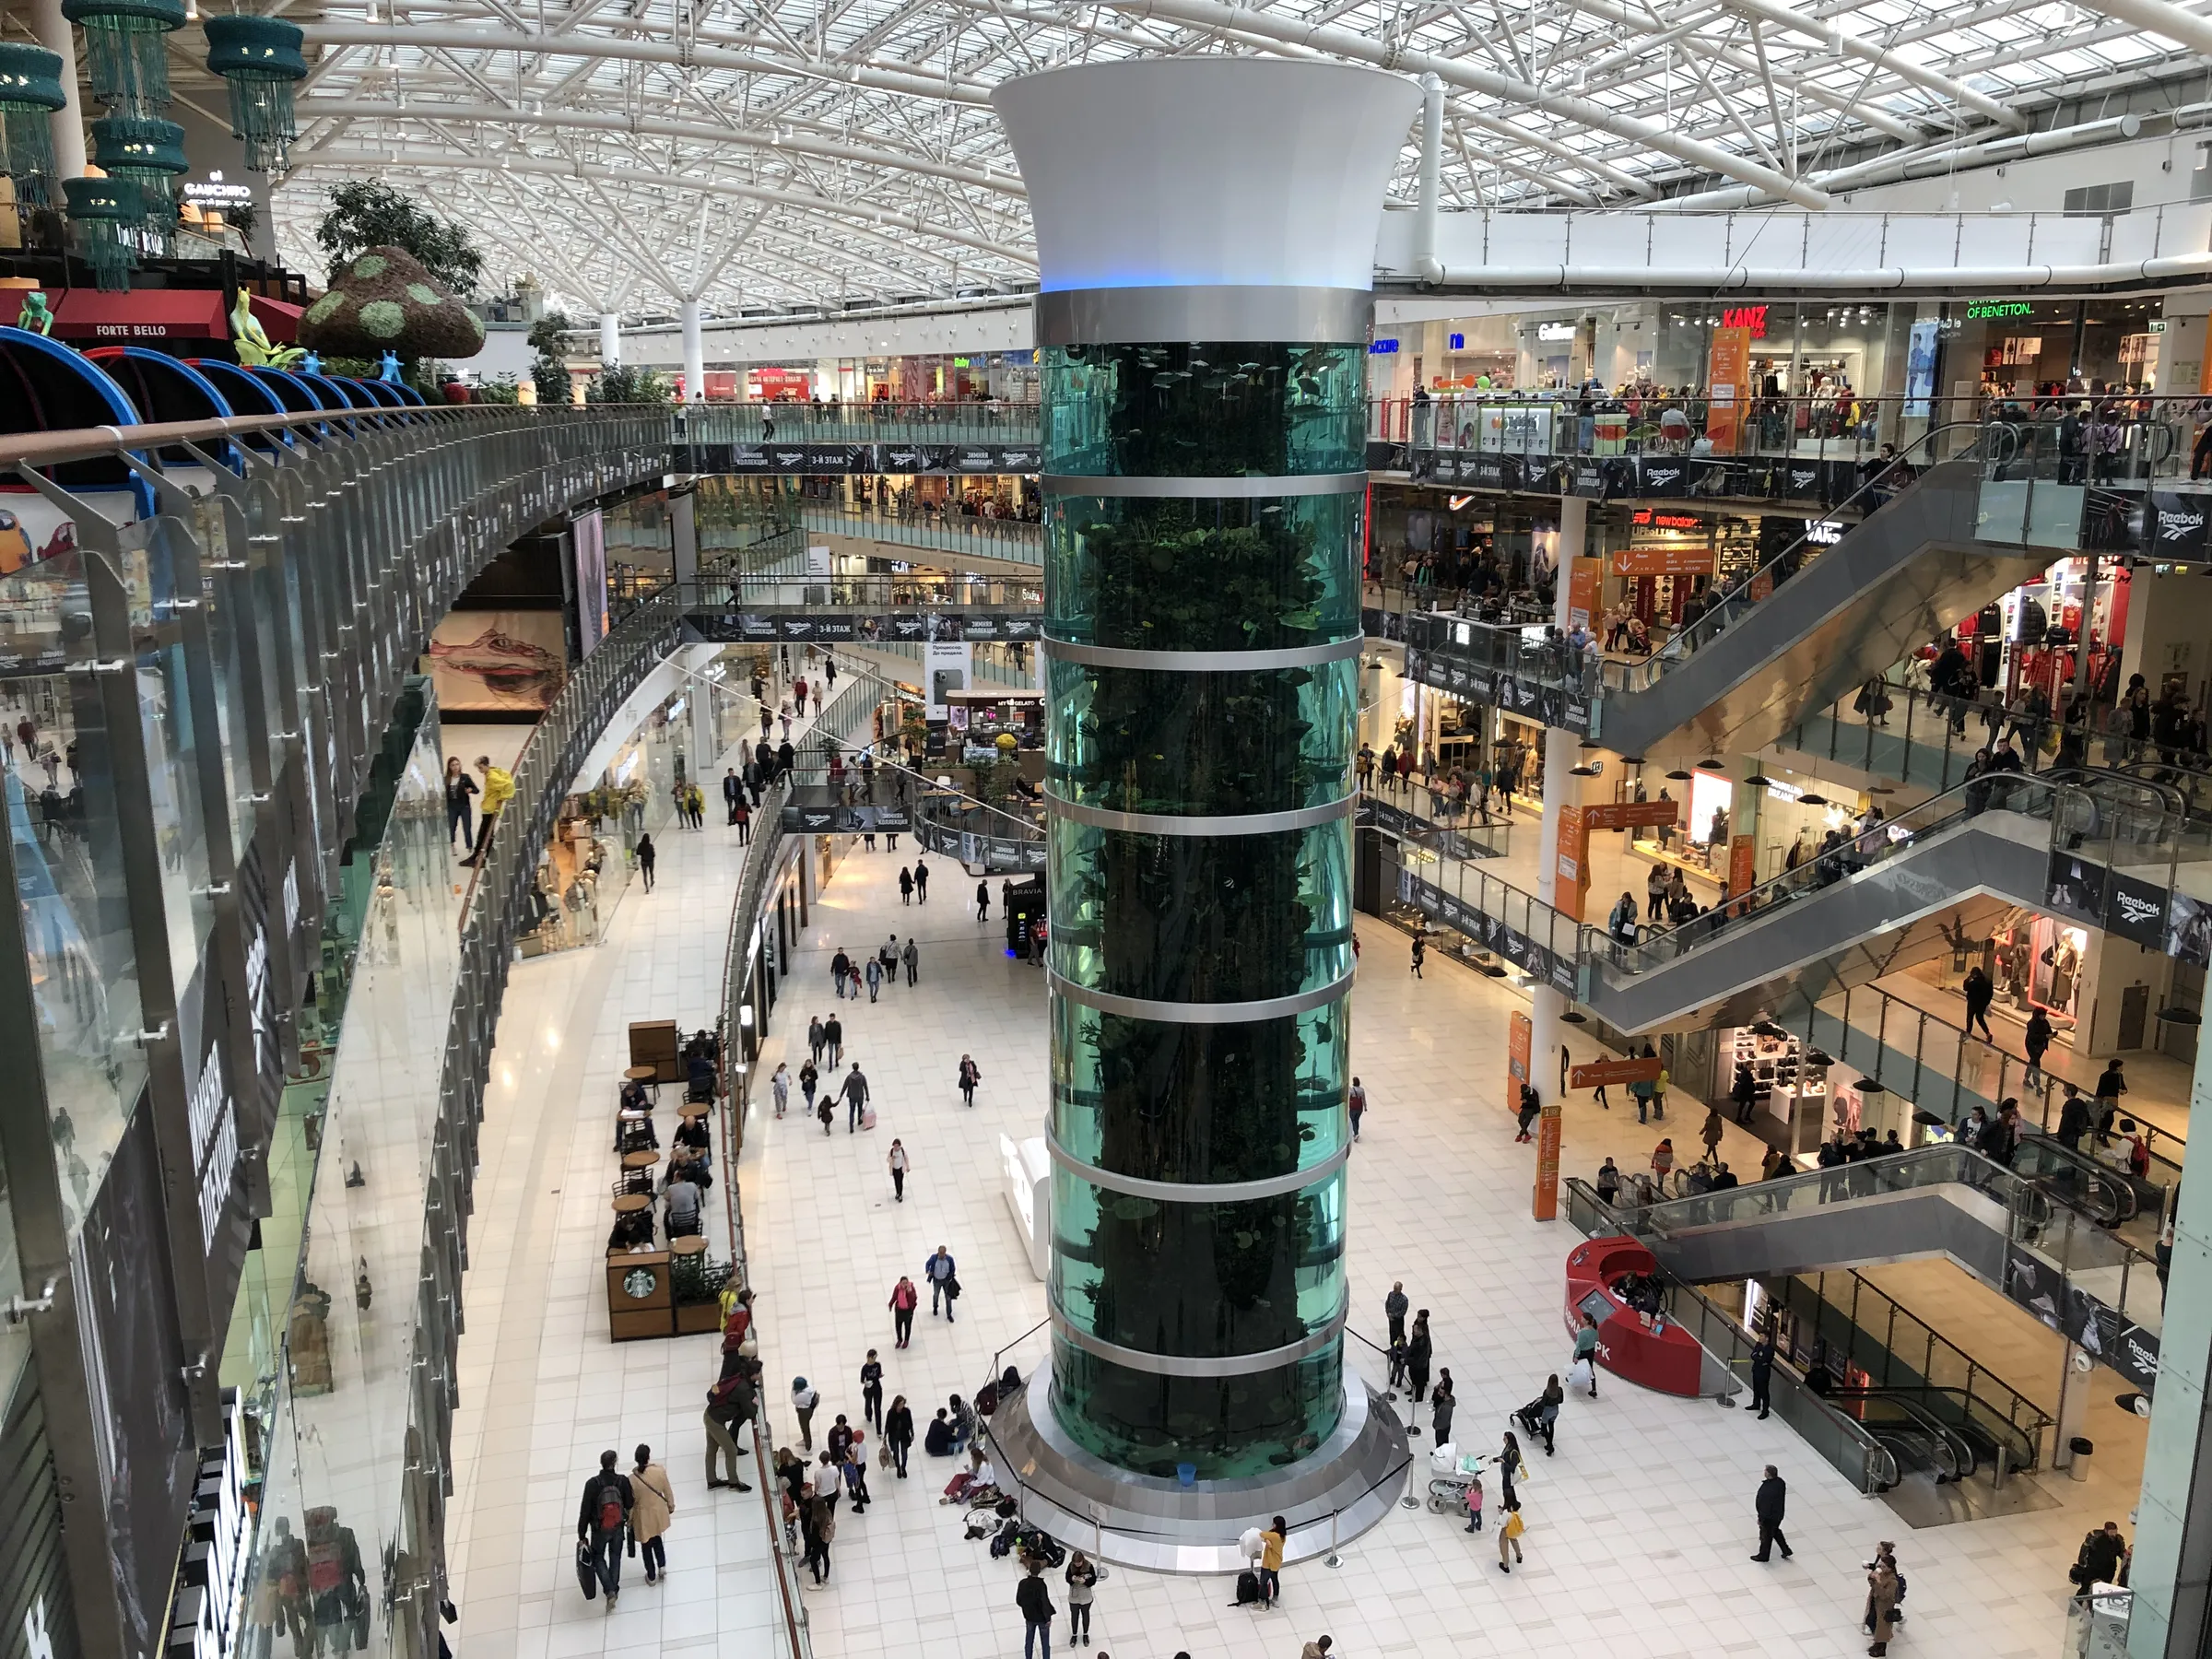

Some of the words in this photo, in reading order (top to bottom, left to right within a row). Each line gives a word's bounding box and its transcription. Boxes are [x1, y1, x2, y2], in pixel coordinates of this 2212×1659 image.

[184, 182, 251, 197] GAUCHITO
[1723, 306, 1767, 329] KANZ
[1967, 308, 1981, 320] OF
[96, 325, 129, 336] FORTE
[134, 325, 167, 336] BELLO
[1538, 323, 1576, 341] Gulliver
[1460, 461, 1477, 471] Reebok
[1529, 465, 1547, 474] Reebok
[1646, 468, 1680, 477] Reebok
[1791, 469, 1816, 480] Reebok
[1656, 515, 1672, 526] new
[2158, 510, 2204, 528] Reebok
[1517, 690, 1535, 701] Reebok
[941, 834, 959, 845] Reebok
[1027, 849, 1046, 857] Reebo
[1442, 900, 1458, 913] Reebok
[2117, 890, 2160, 916] Reebok
[1508, 936, 1524, 952] Reebok
[188, 1039, 223, 1177] ИМНЯЯ
[2128, 1337, 2159, 1366] Reeb
